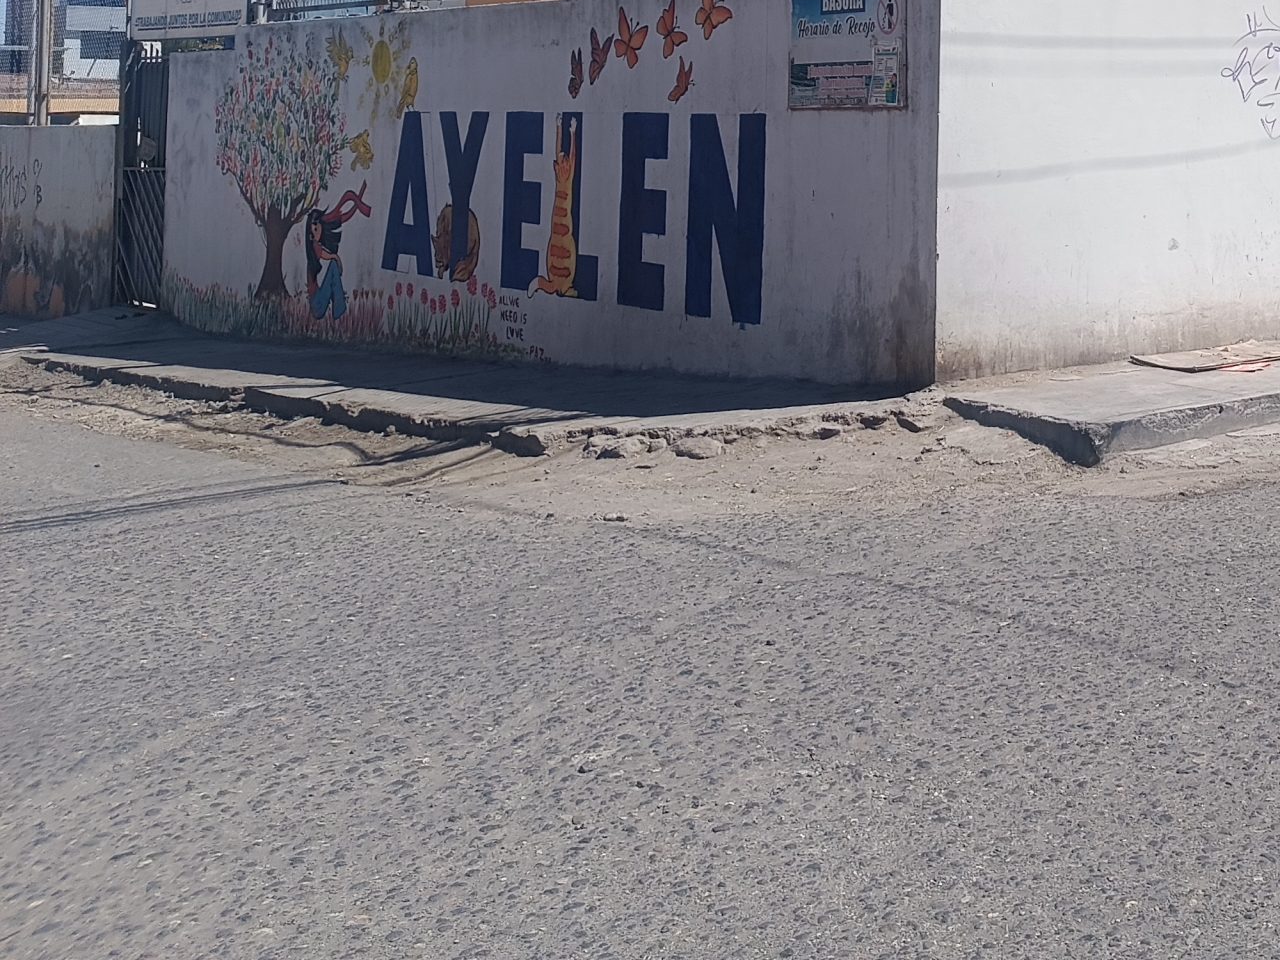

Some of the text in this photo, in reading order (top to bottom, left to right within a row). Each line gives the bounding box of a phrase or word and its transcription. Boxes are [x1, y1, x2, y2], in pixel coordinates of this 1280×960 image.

[168, 14, 188, 25] JUNTOS
[199, 12, 207, 23] LA
[797, 16, 876, 38] Horario de Recojo
[381, 110, 767, 325] AYELEN
[500, 309, 527, 325] NEED IS
